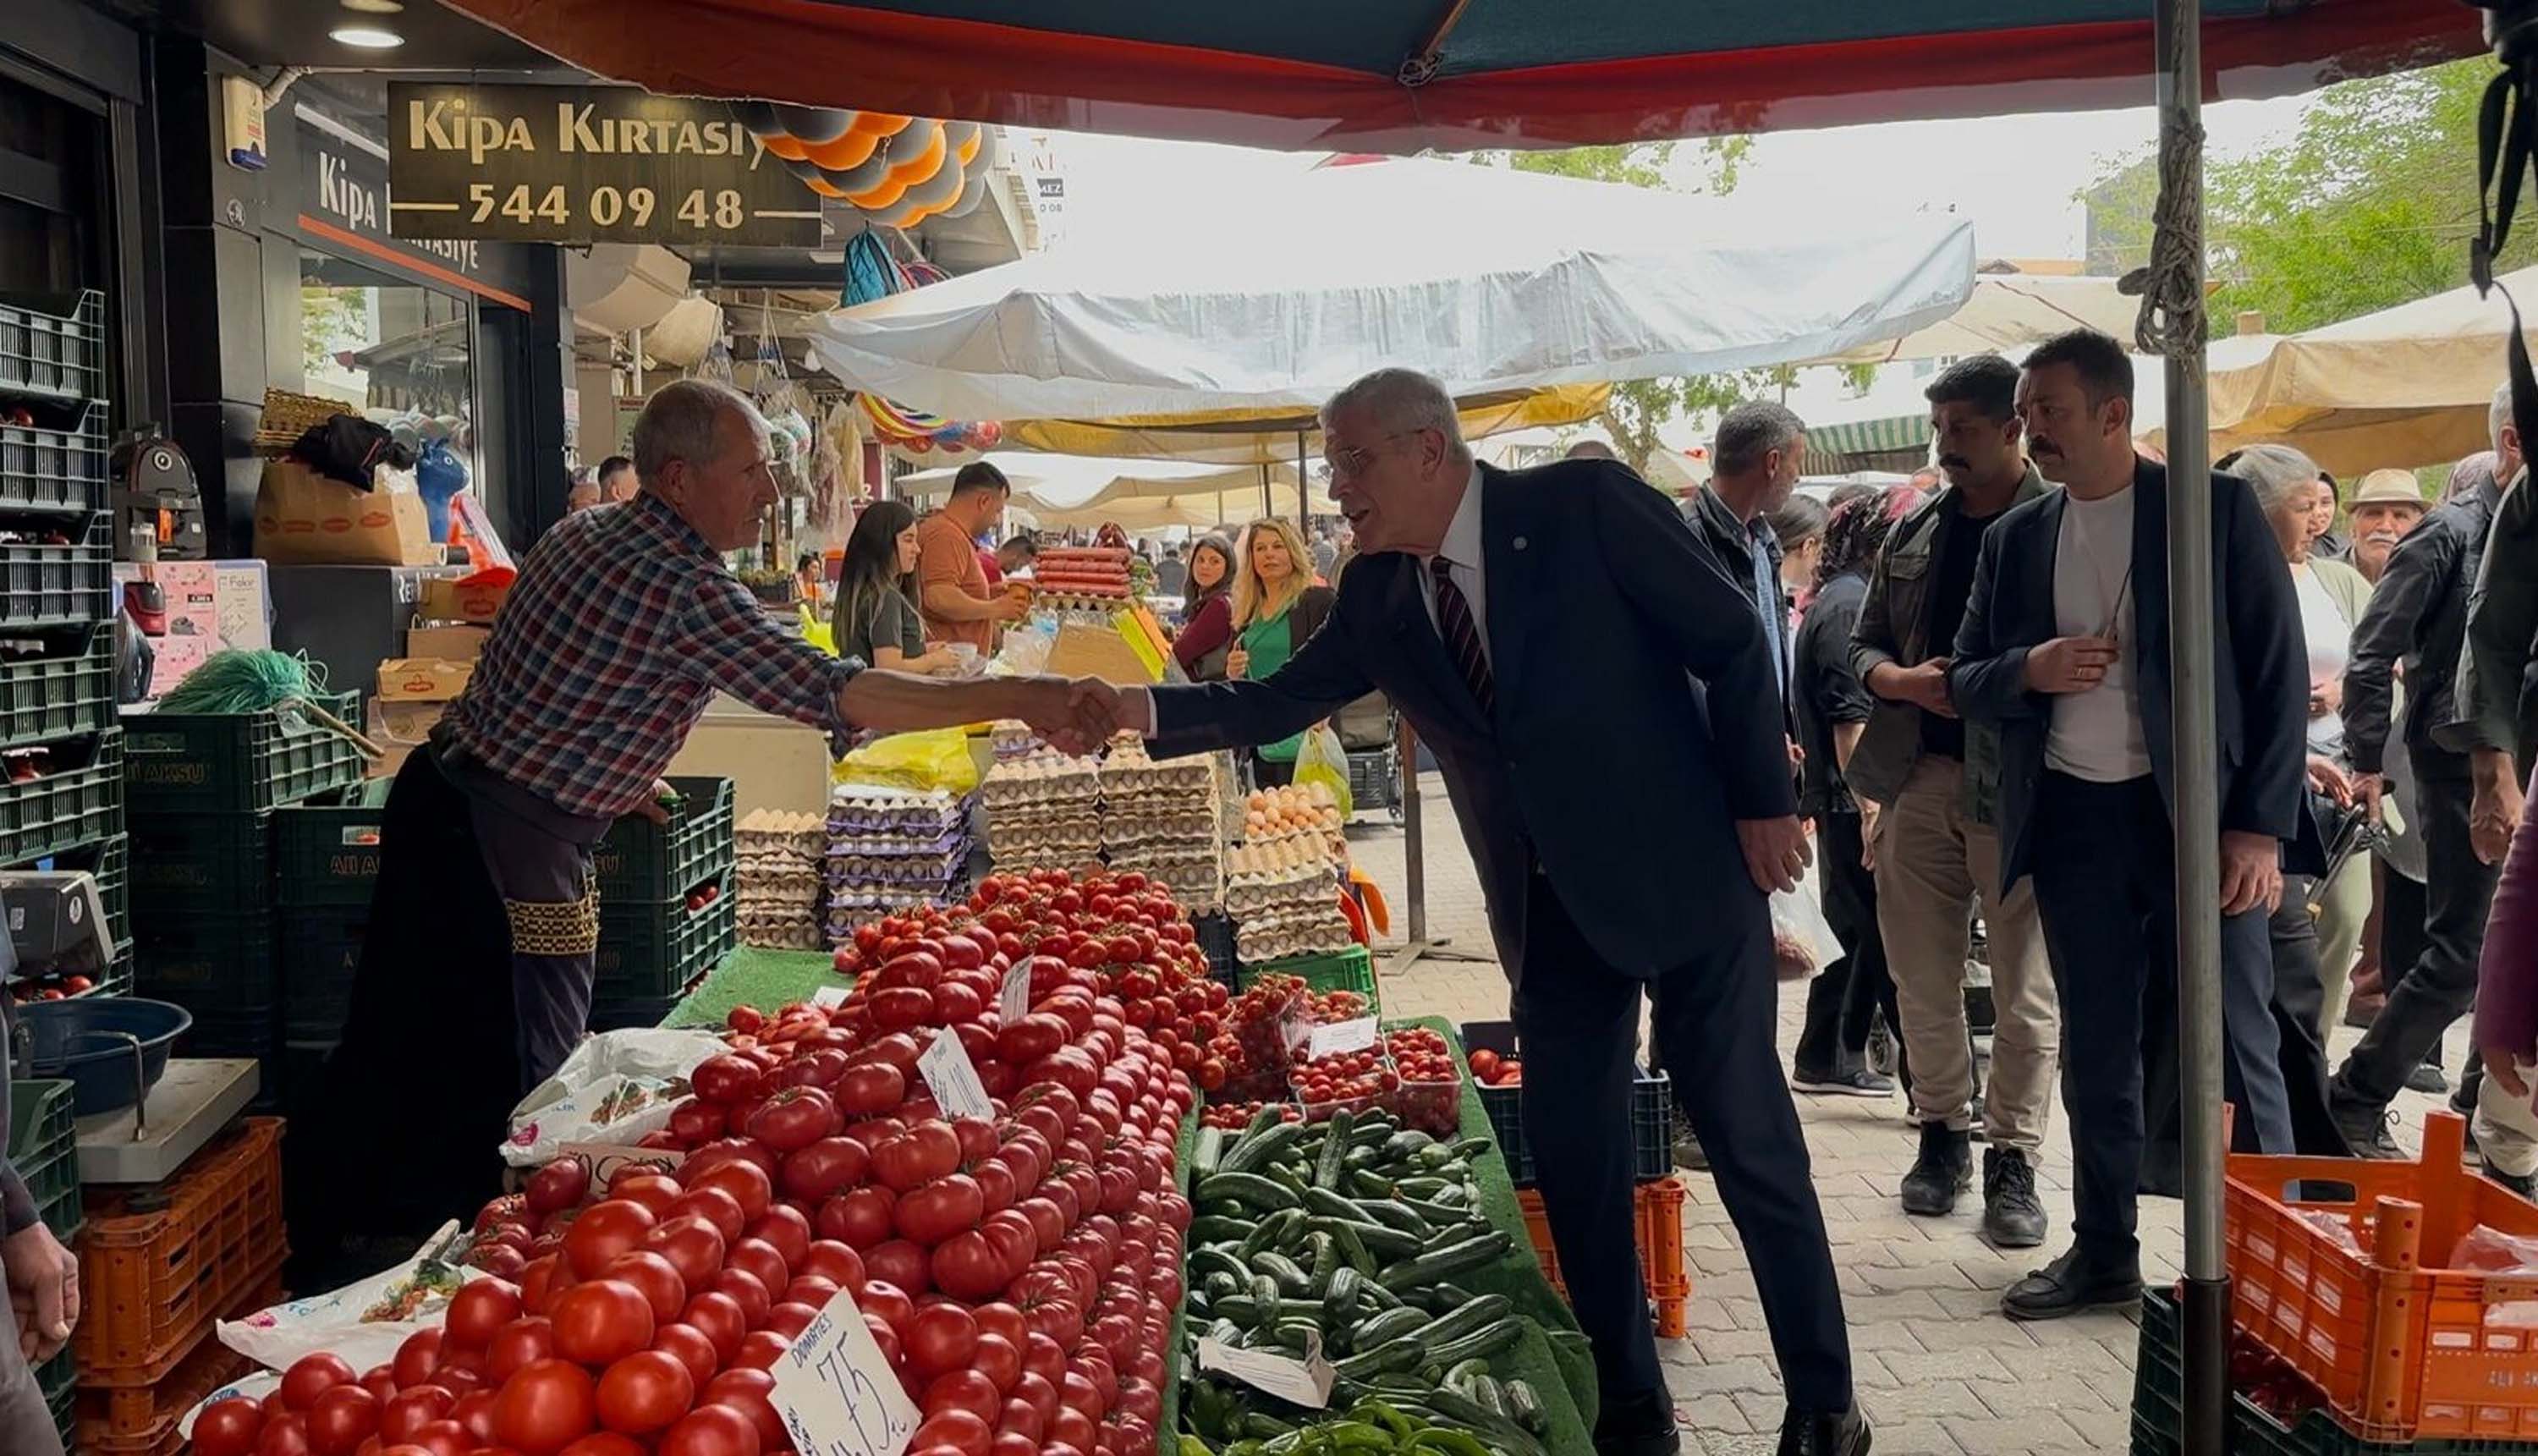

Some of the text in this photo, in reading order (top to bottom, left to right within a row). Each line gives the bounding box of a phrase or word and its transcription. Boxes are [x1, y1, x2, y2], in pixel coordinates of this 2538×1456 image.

[469, 184, 744, 228] 544 09 48
